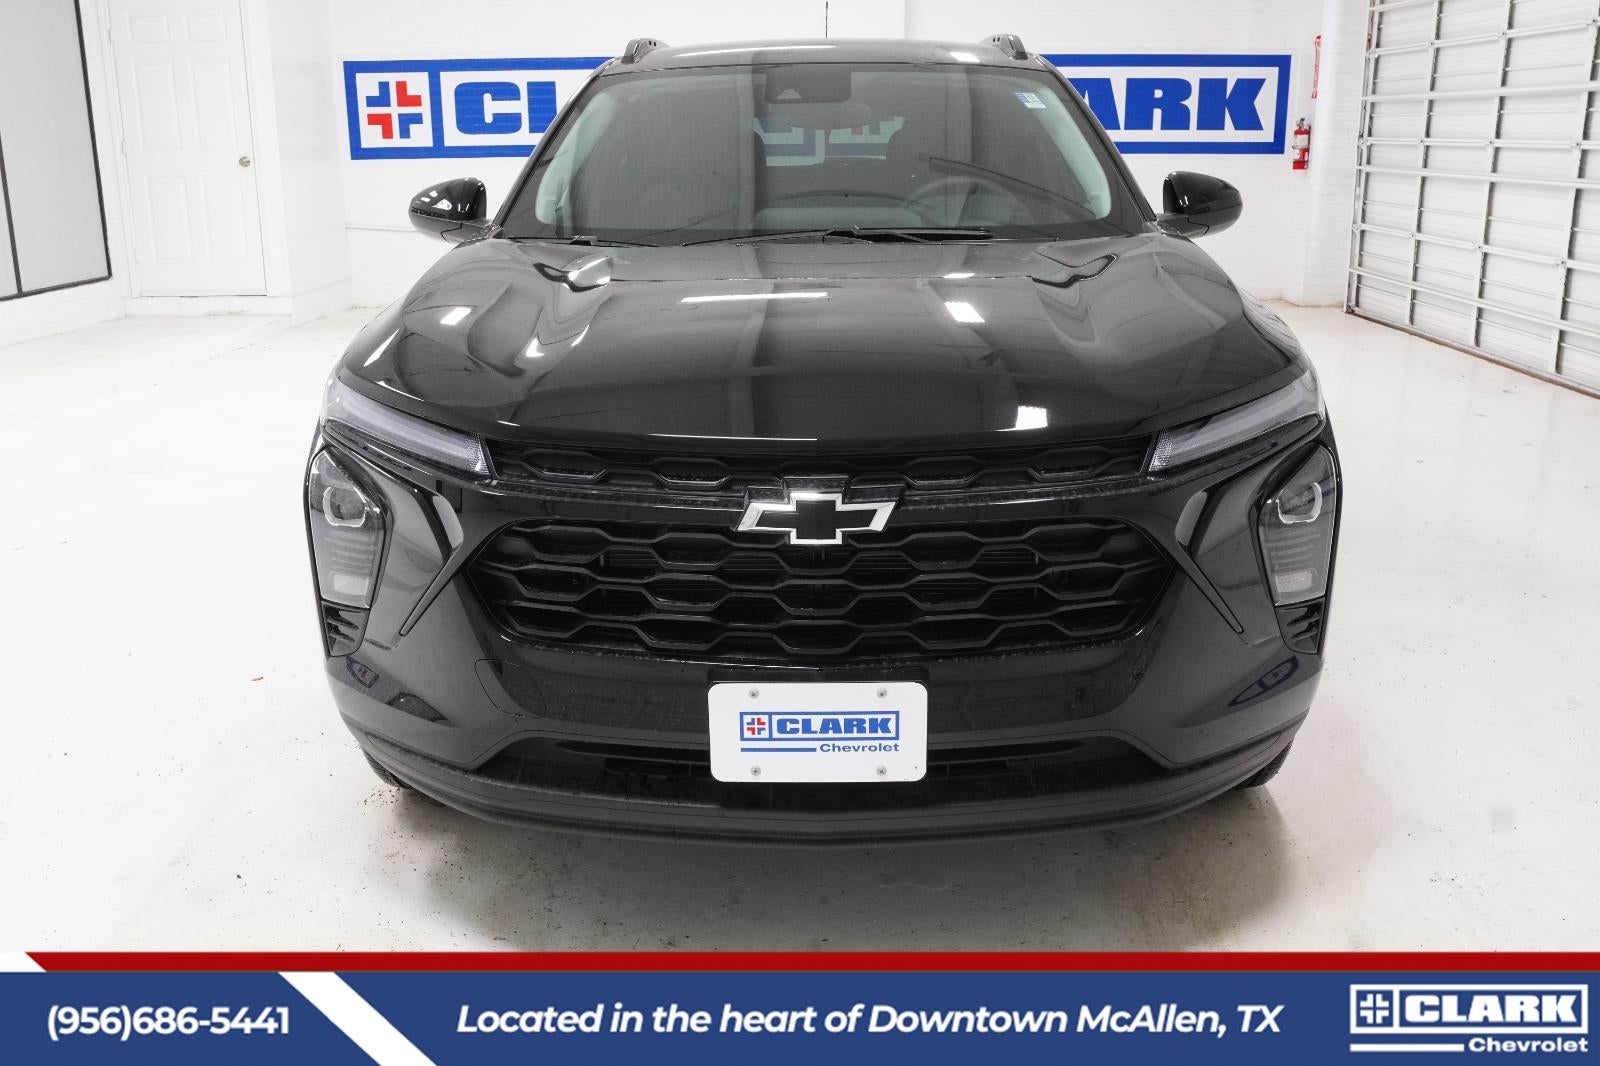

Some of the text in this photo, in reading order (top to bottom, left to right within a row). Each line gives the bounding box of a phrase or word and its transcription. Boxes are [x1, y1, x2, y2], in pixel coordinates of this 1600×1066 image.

[1067, 77, 1266, 131] ARK
[776, 717, 892, 735] CLARK
[819, 742, 900, 753] Chevrolet
